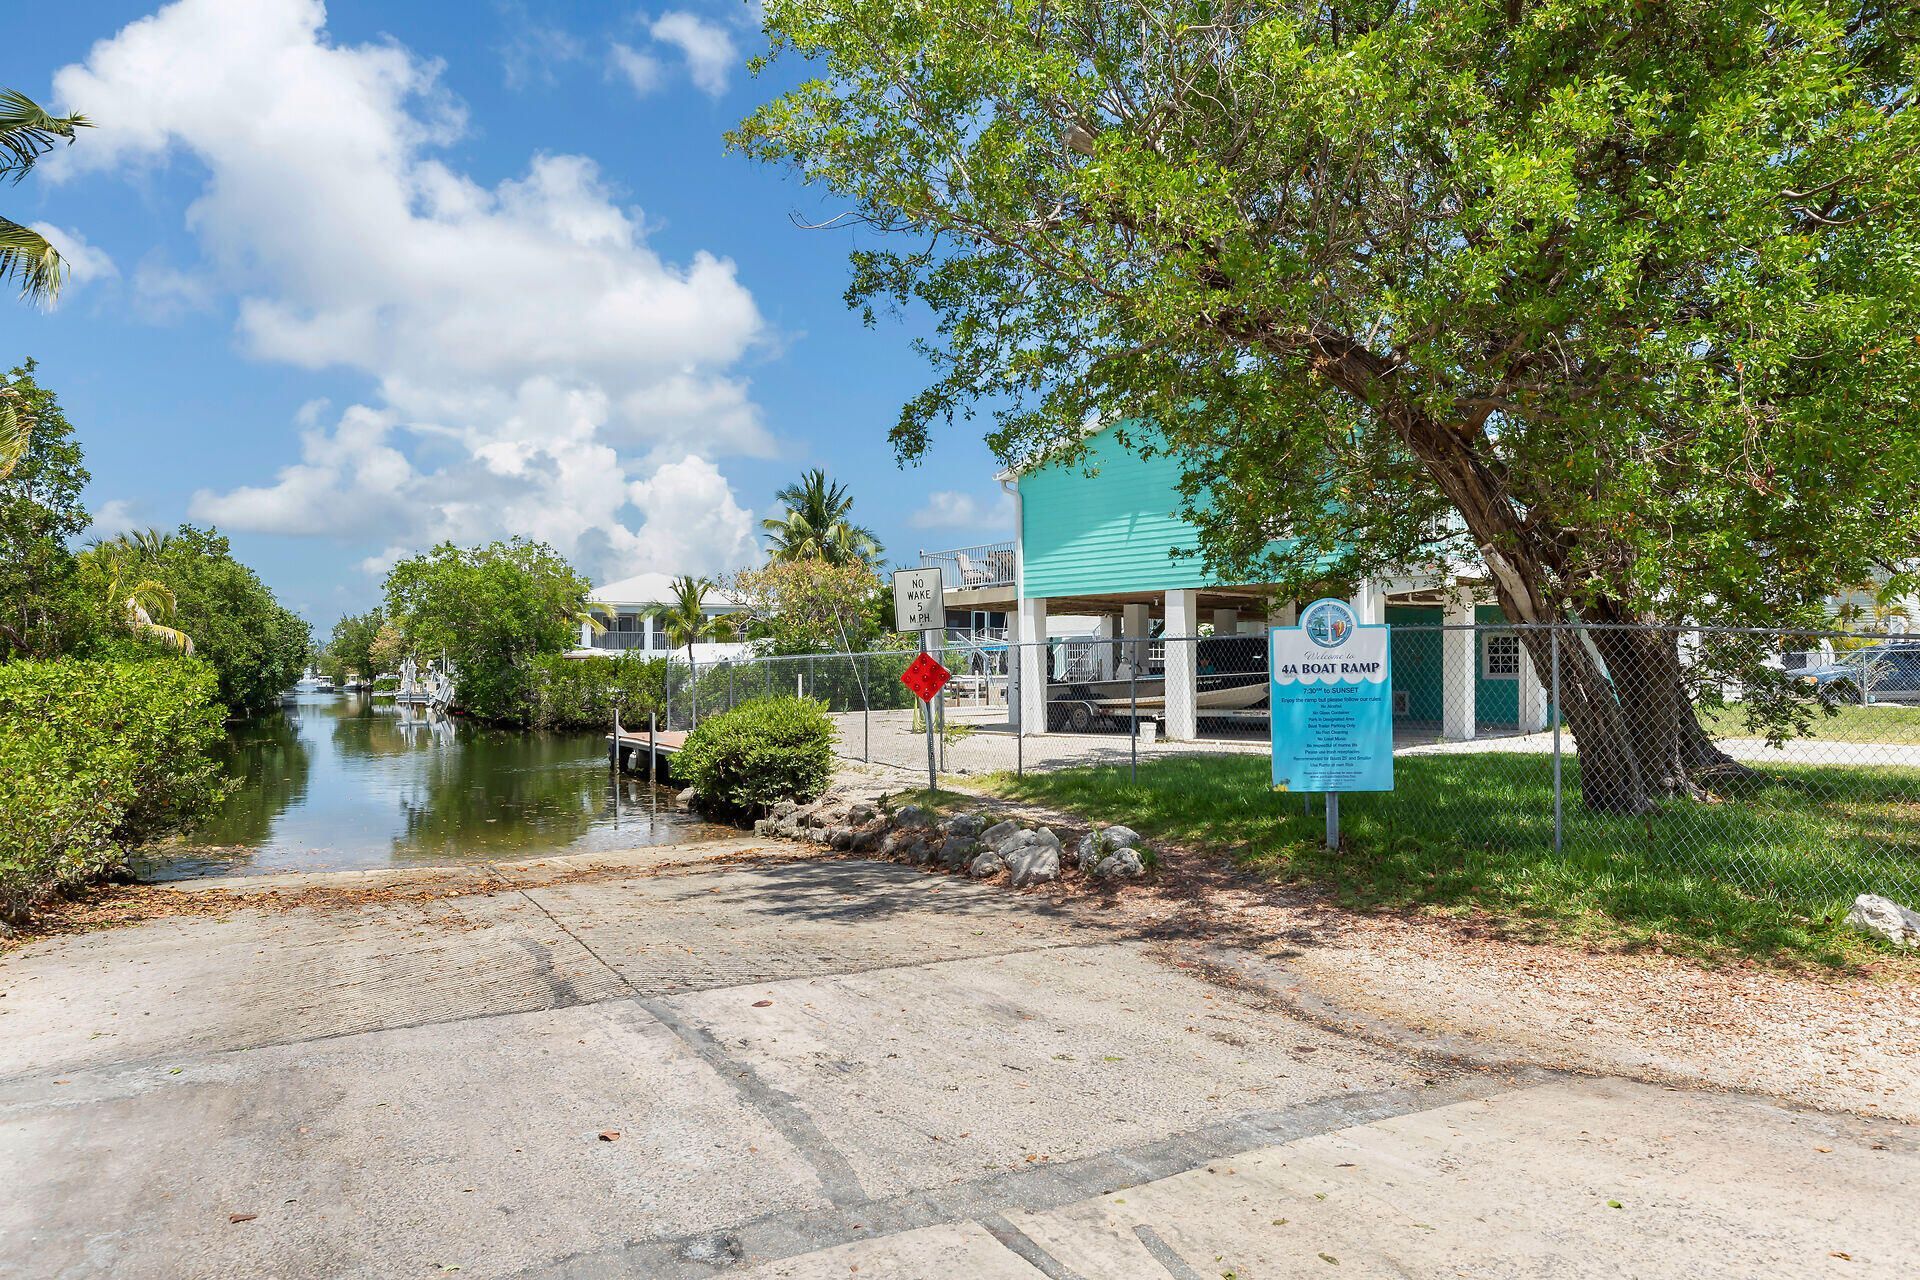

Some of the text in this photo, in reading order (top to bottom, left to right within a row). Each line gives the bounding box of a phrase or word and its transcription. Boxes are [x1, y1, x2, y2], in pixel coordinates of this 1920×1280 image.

[912, 579, 924, 588] NO
[907, 590, 931, 601] WAKE
[917, 602, 923, 611] 5
[909, 613, 933, 623] M.P.H.
[1304, 650, 1354, 661] Welcome to
[1281, 662, 1380, 674] 4A BOAT RAMP
